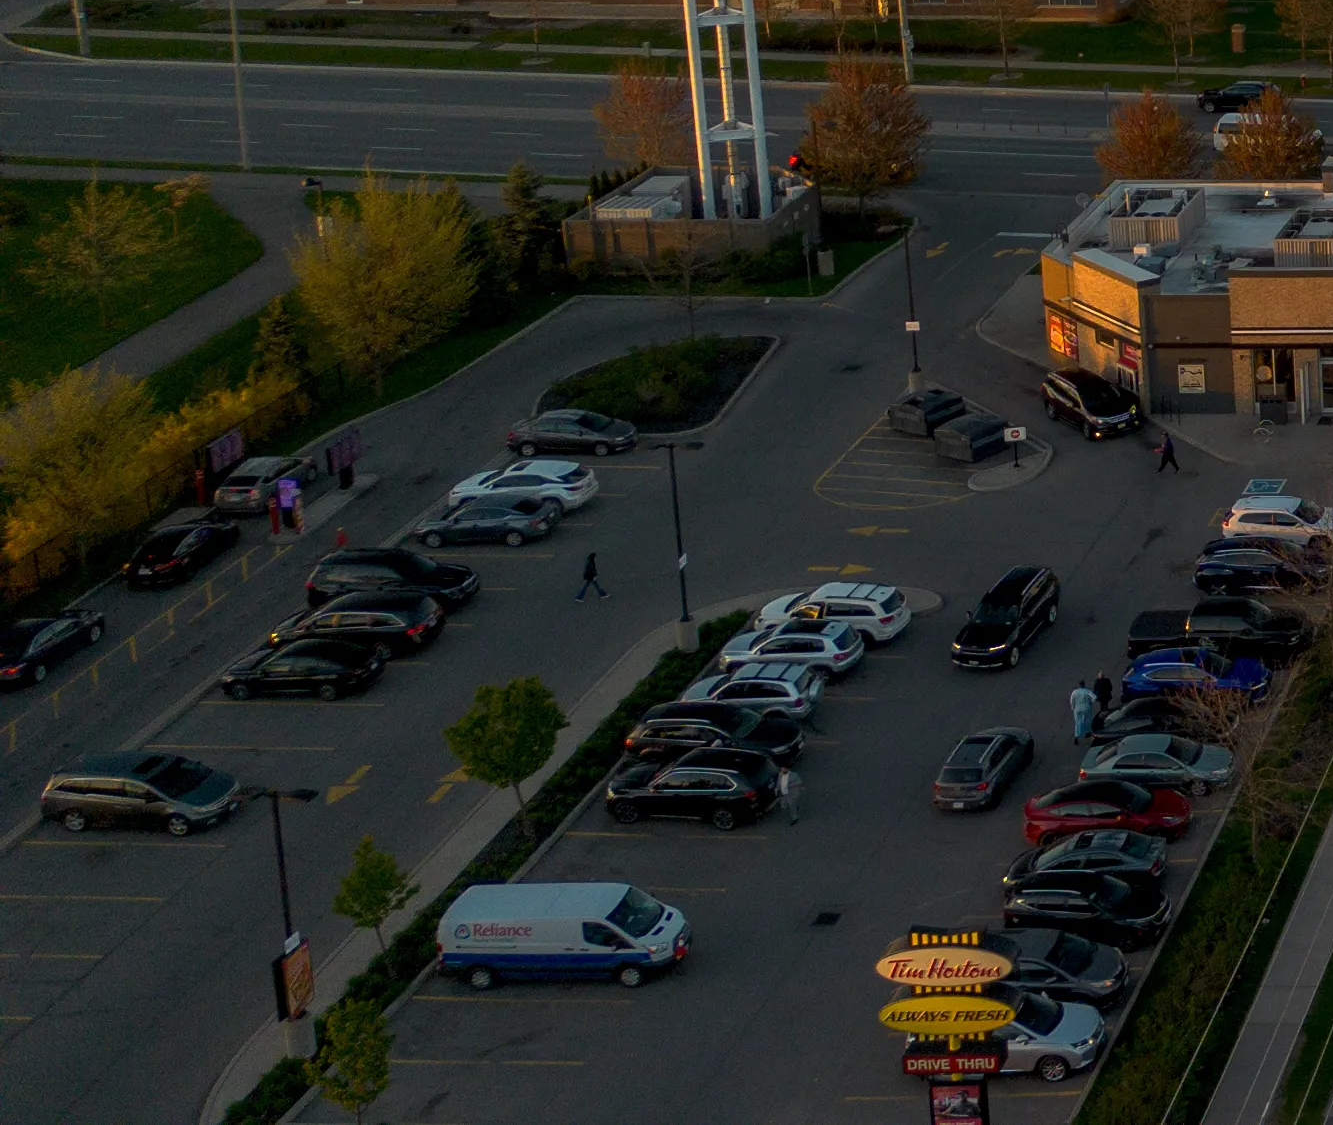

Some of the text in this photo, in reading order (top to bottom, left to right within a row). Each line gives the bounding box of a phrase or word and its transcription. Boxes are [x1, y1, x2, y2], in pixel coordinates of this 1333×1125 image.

[473, 923, 533, 937] Reliance
[888, 957, 1001, 980] Tim Hortons
[884, 1009, 1010, 1022] ALWAYS FRESH
[907, 1057, 996, 1072] DRIVE THRU
